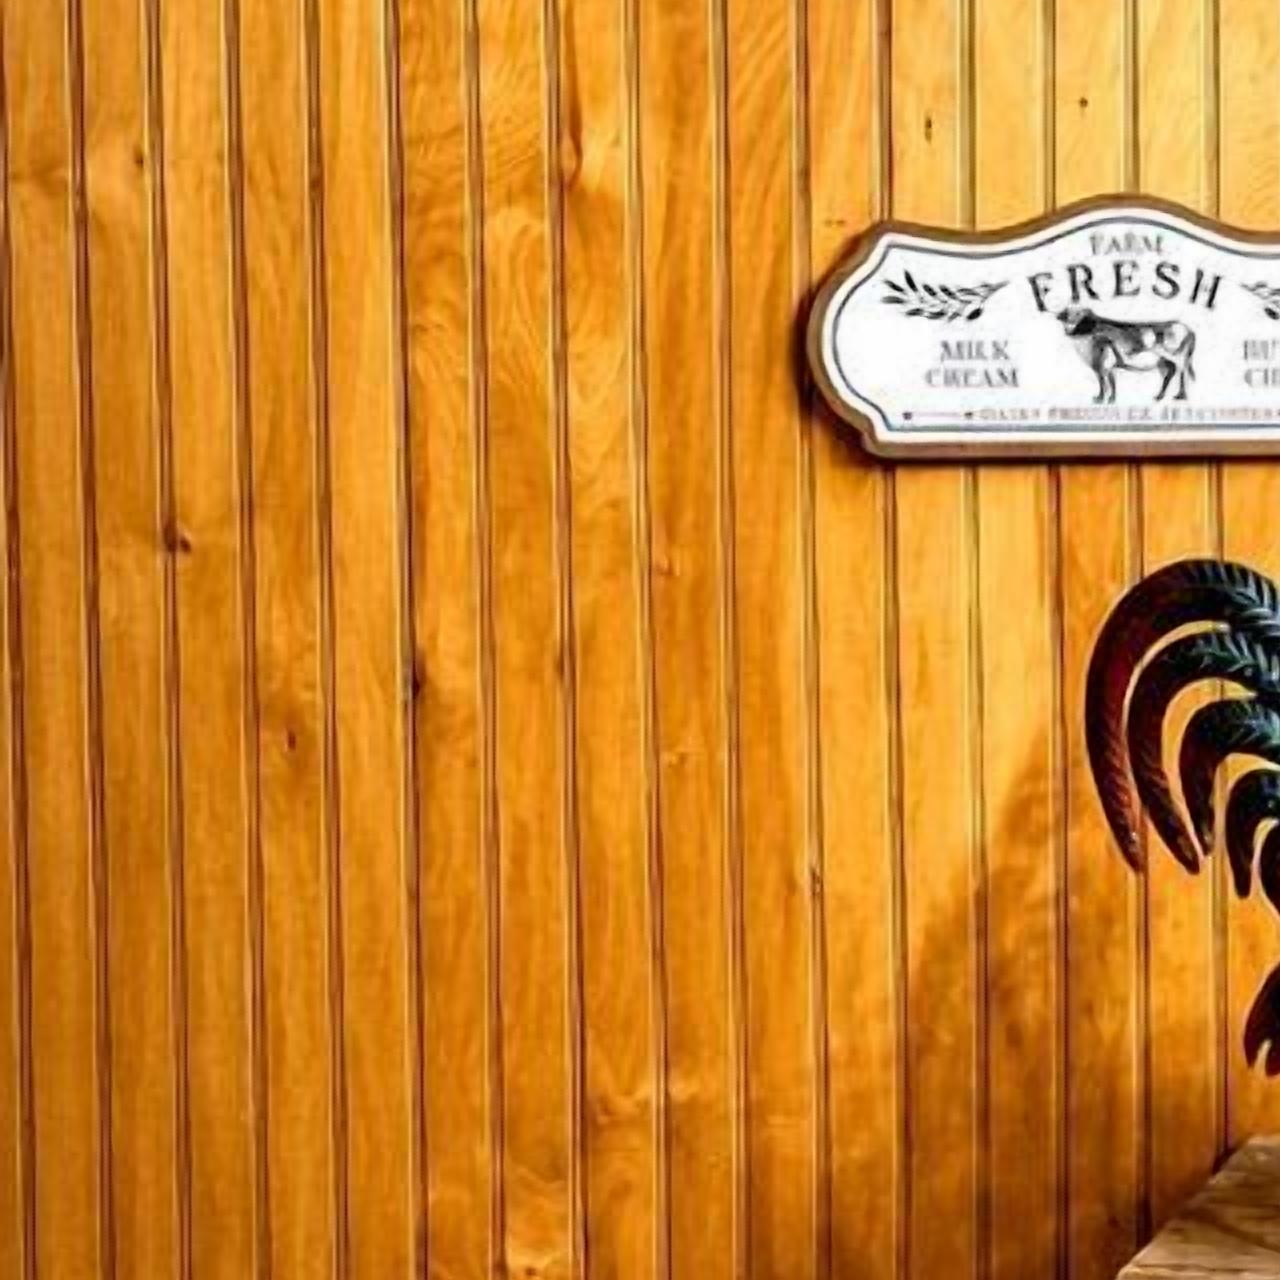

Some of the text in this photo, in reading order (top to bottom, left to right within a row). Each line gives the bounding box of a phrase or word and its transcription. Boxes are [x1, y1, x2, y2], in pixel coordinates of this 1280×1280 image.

[1089, 231, 1164, 256] FARM
[1026, 258, 1225, 313] FRESH
[940, 339, 1011, 362] MILK
[924, 367, 1020, 388] CREAM
